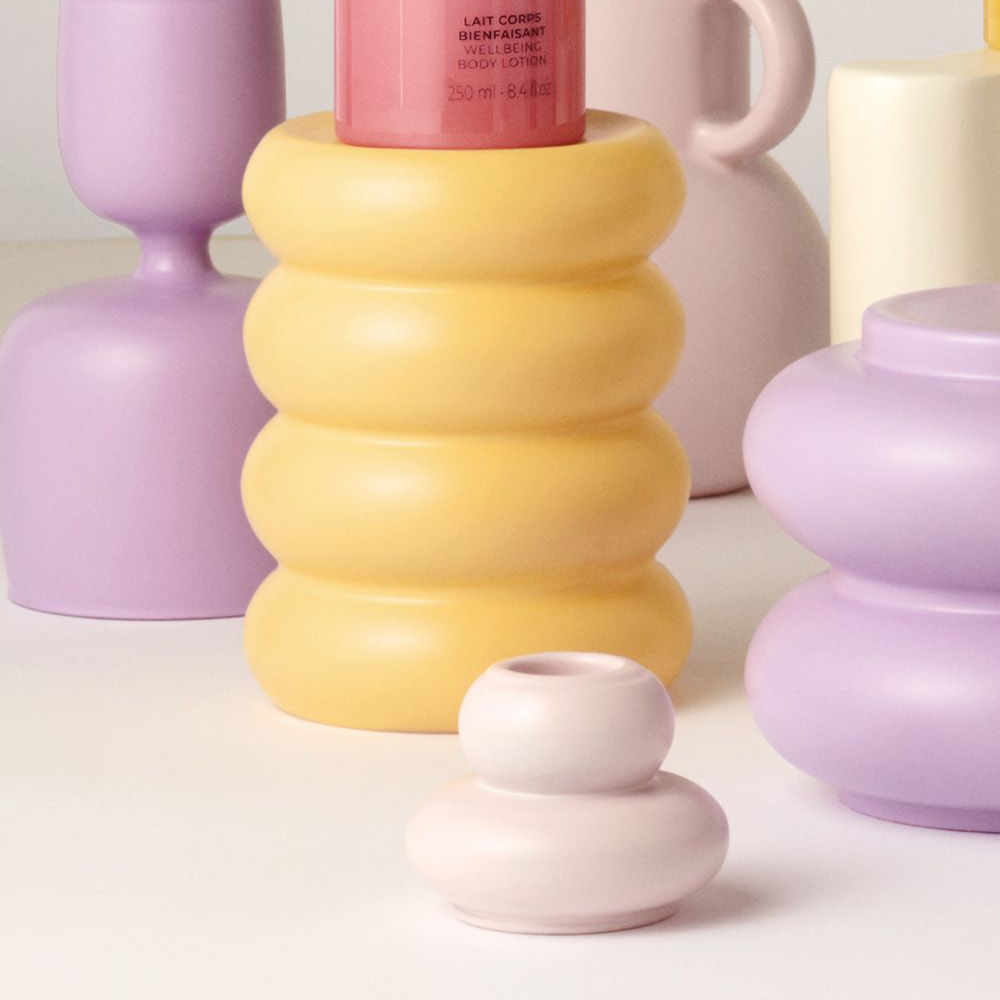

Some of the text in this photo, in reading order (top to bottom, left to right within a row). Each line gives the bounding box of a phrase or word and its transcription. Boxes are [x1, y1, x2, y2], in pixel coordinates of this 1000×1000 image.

[464, 13, 542, 27] LAIT CORPS
[458, 26, 546, 41] BIENFAISANT
[464, 41, 542, 55] WELLBEING
[457, 55, 547, 70] BODY LOTION
[447, 84, 473, 101] 250
[478, 83, 496, 100] ml
